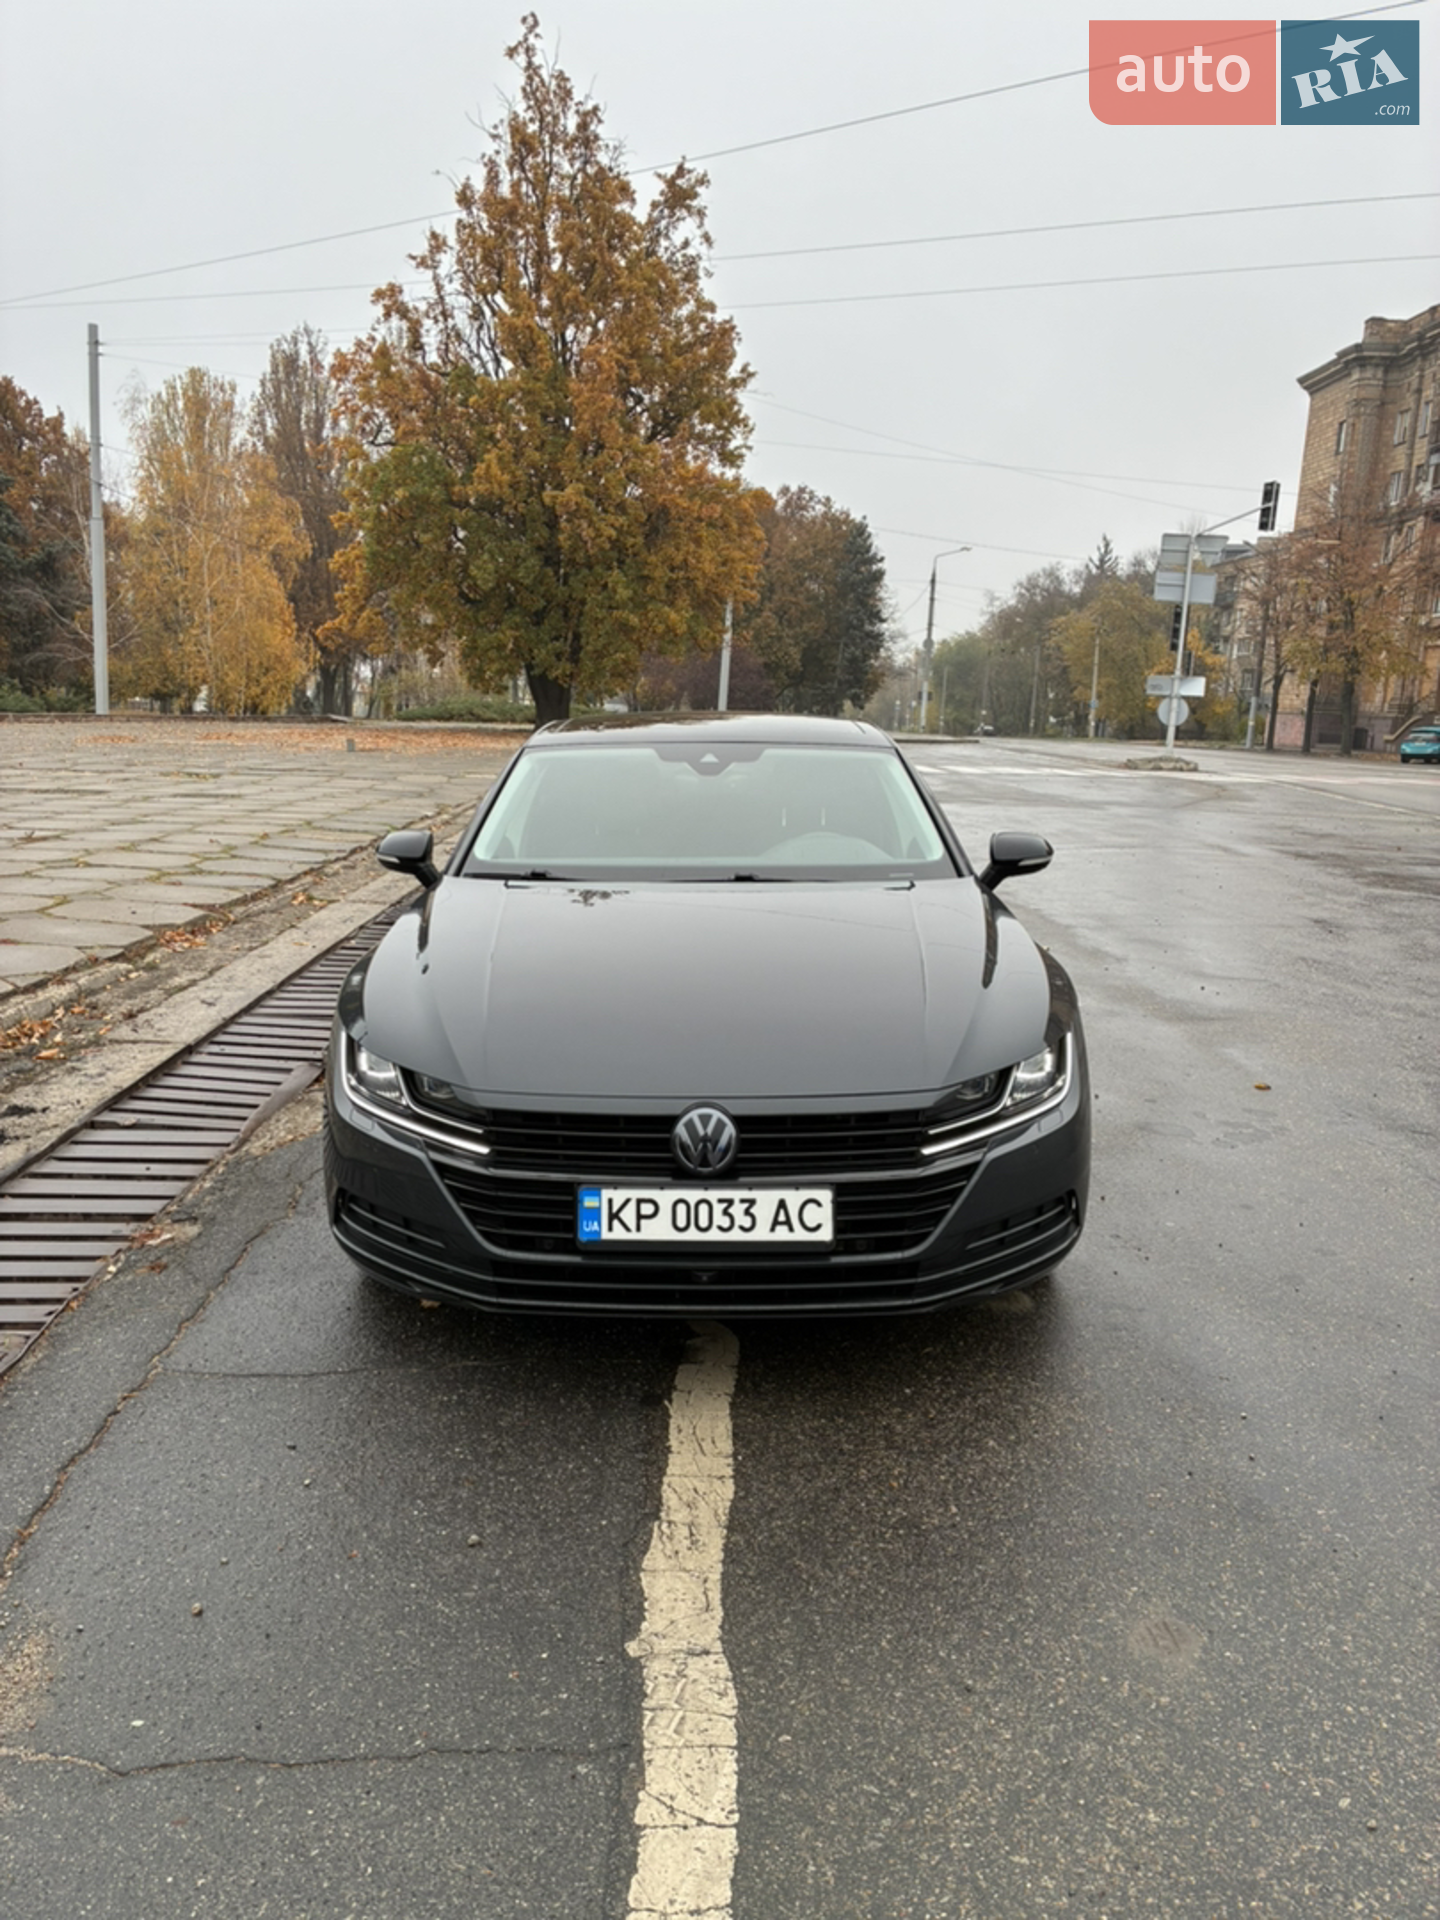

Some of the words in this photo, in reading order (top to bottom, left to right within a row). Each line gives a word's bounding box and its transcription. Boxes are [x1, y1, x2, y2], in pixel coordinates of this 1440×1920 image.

[583, 1220, 600, 1232] UA
[607, 1197, 660, 1233] KP
[671, 1197, 757, 1233] 0033
[769, 1197, 824, 1233] AC
